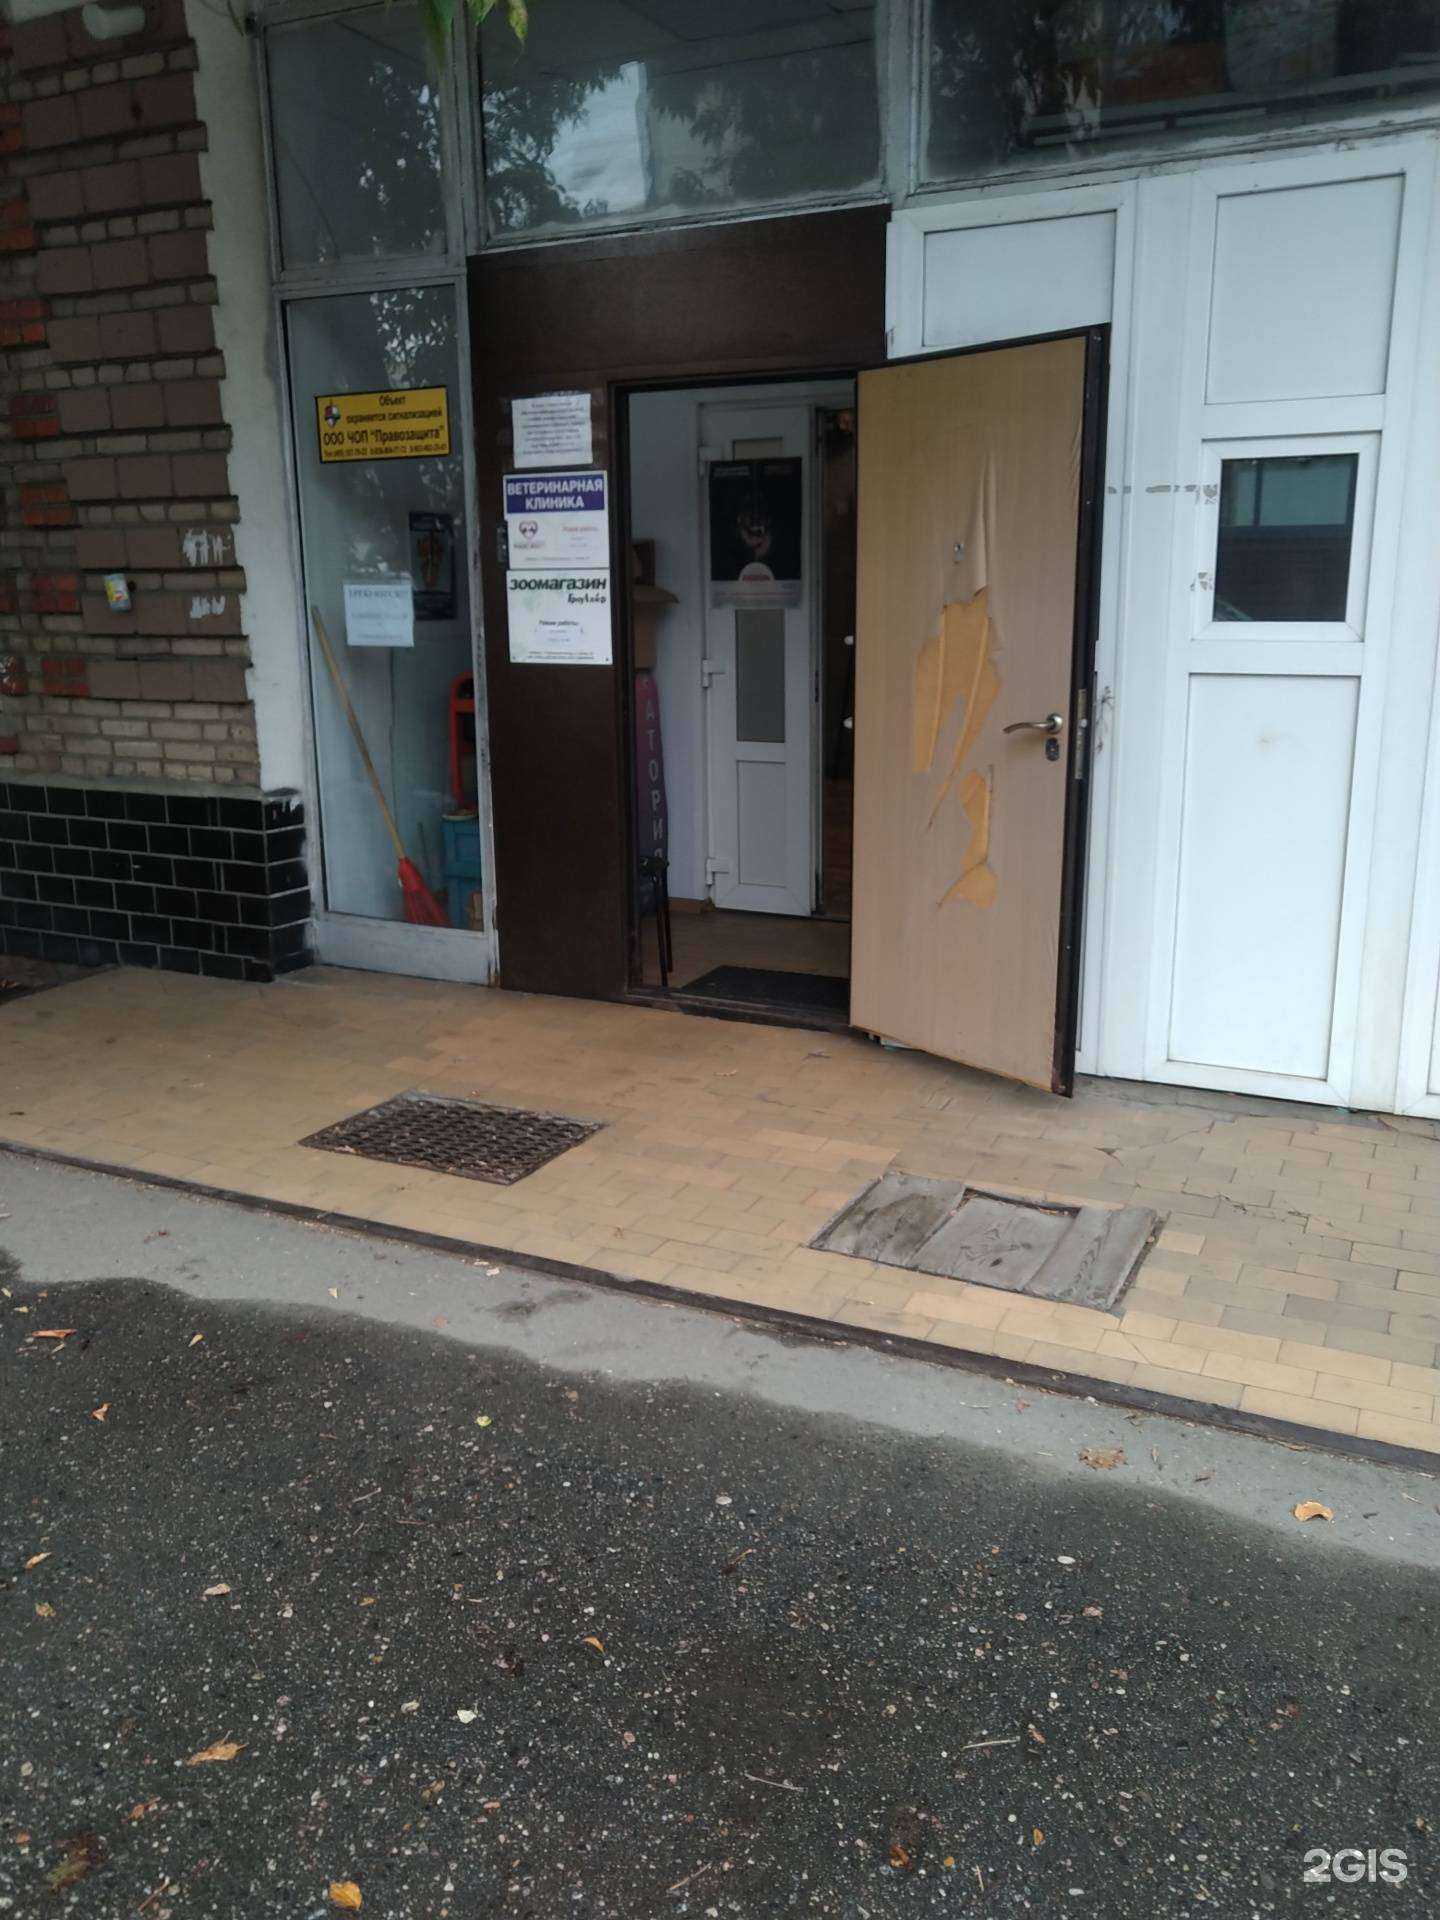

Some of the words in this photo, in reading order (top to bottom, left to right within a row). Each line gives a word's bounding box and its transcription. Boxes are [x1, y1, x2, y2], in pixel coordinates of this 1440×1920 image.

[379, 395, 406, 406] Объект
[386, 407, 442, 420] сигнализацией
[323, 432, 345, 446] ООО
[347, 430, 369, 444] ЧОП
[507, 478, 603, 495] ВЕТЕРИНАРНАЯ
[525, 496, 585, 510] КЛИНИКА
